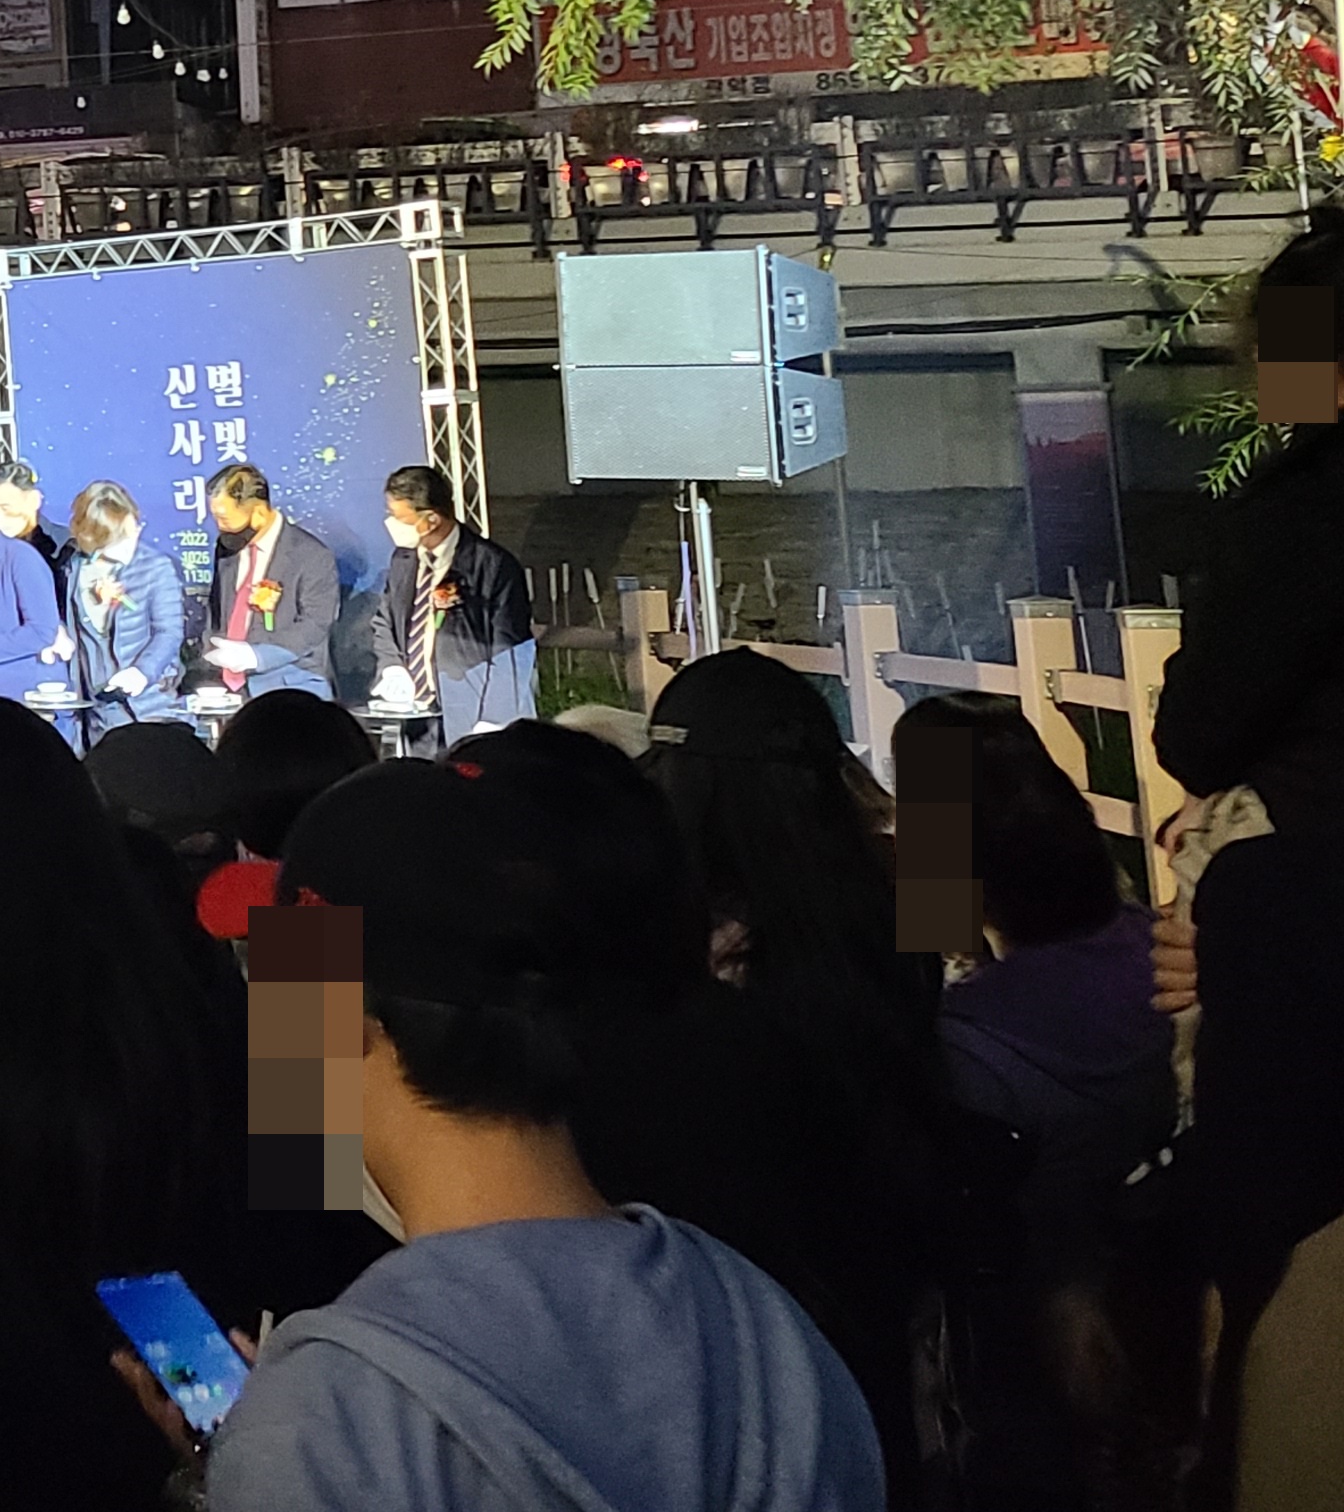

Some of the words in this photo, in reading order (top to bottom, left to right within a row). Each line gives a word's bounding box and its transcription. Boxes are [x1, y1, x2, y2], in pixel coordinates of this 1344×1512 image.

[164, 364, 208, 525] 신사리
[205, 360, 248, 464] 별빛
[180, 531, 210, 547] 2022
